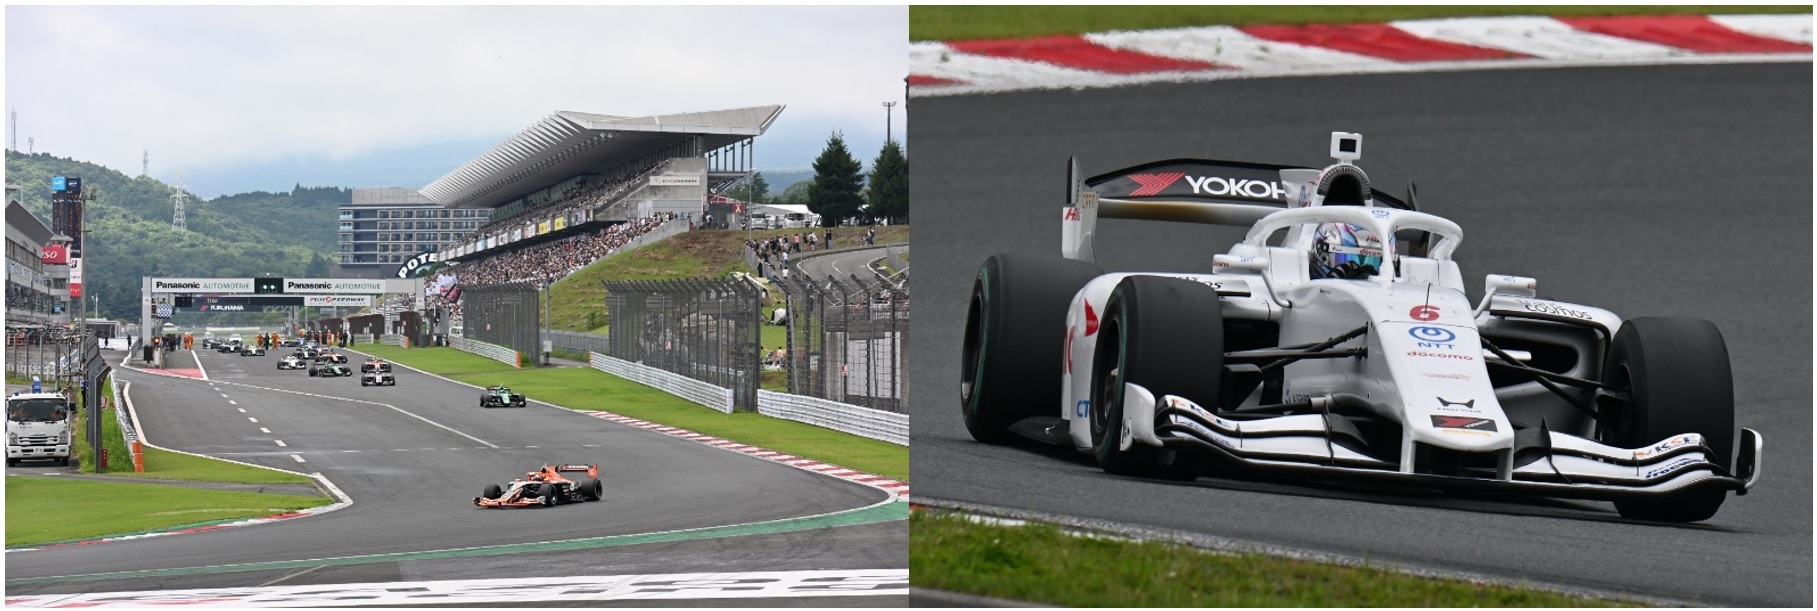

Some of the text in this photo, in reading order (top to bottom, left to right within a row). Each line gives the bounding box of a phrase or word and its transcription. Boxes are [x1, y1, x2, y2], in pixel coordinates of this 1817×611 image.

[156, 281, 250, 290] Panasonic AUTOMOTIVE
[288, 281, 332, 290] Panasonic
[1409, 304, 1441, 322] 6
[1524, 303, 1593, 320] cosmos
[1417, 342, 1455, 350] NTT
[1407, 351, 1474, 361] docomo
